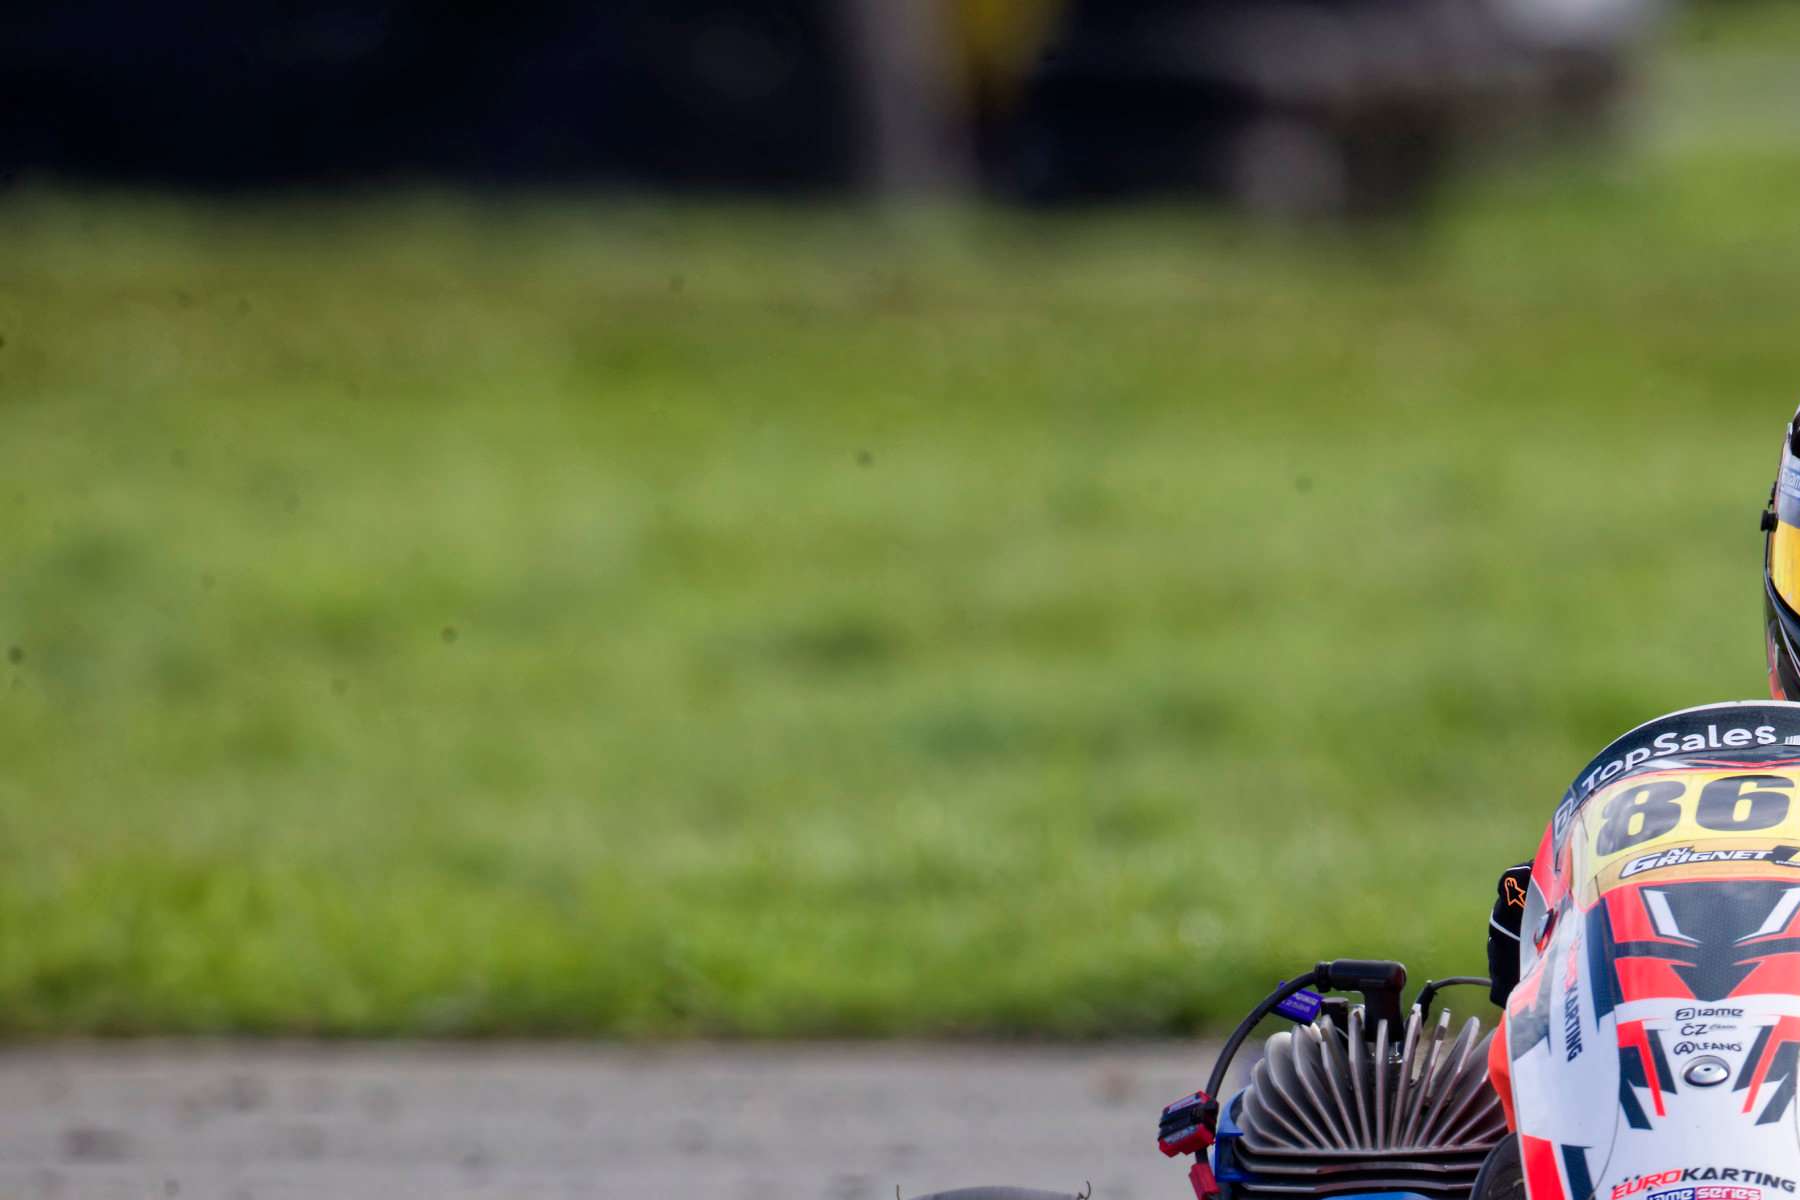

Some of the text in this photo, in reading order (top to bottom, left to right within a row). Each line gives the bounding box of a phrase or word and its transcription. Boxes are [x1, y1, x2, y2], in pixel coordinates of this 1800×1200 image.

[1580, 724, 1777, 794] TopSales
[1620, 850, 1774, 878] GRIGNET
[1673, 1041, 1742, 1056] ALFANO
[1611, 1167, 1797, 1200] EUROKARTING
